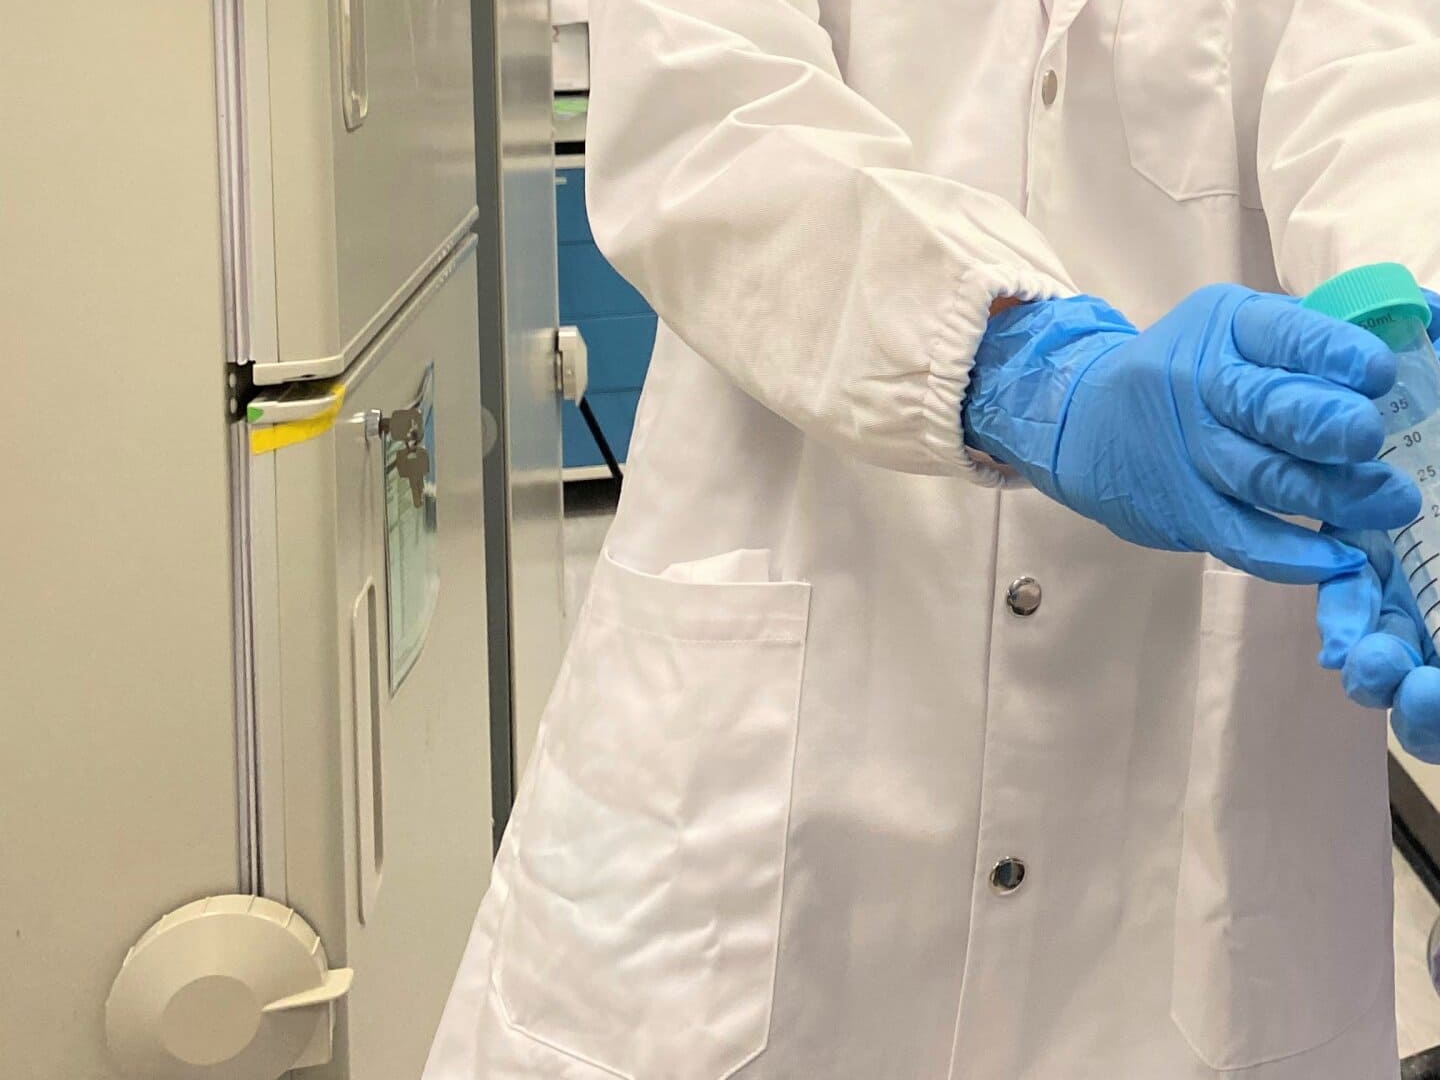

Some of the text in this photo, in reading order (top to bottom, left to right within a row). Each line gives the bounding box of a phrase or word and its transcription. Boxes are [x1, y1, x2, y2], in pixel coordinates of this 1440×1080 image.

[1390, 398, 1409, 414] 35
[1403, 431, 1422, 448] 30
[1417, 465, 1437, 482] 25
